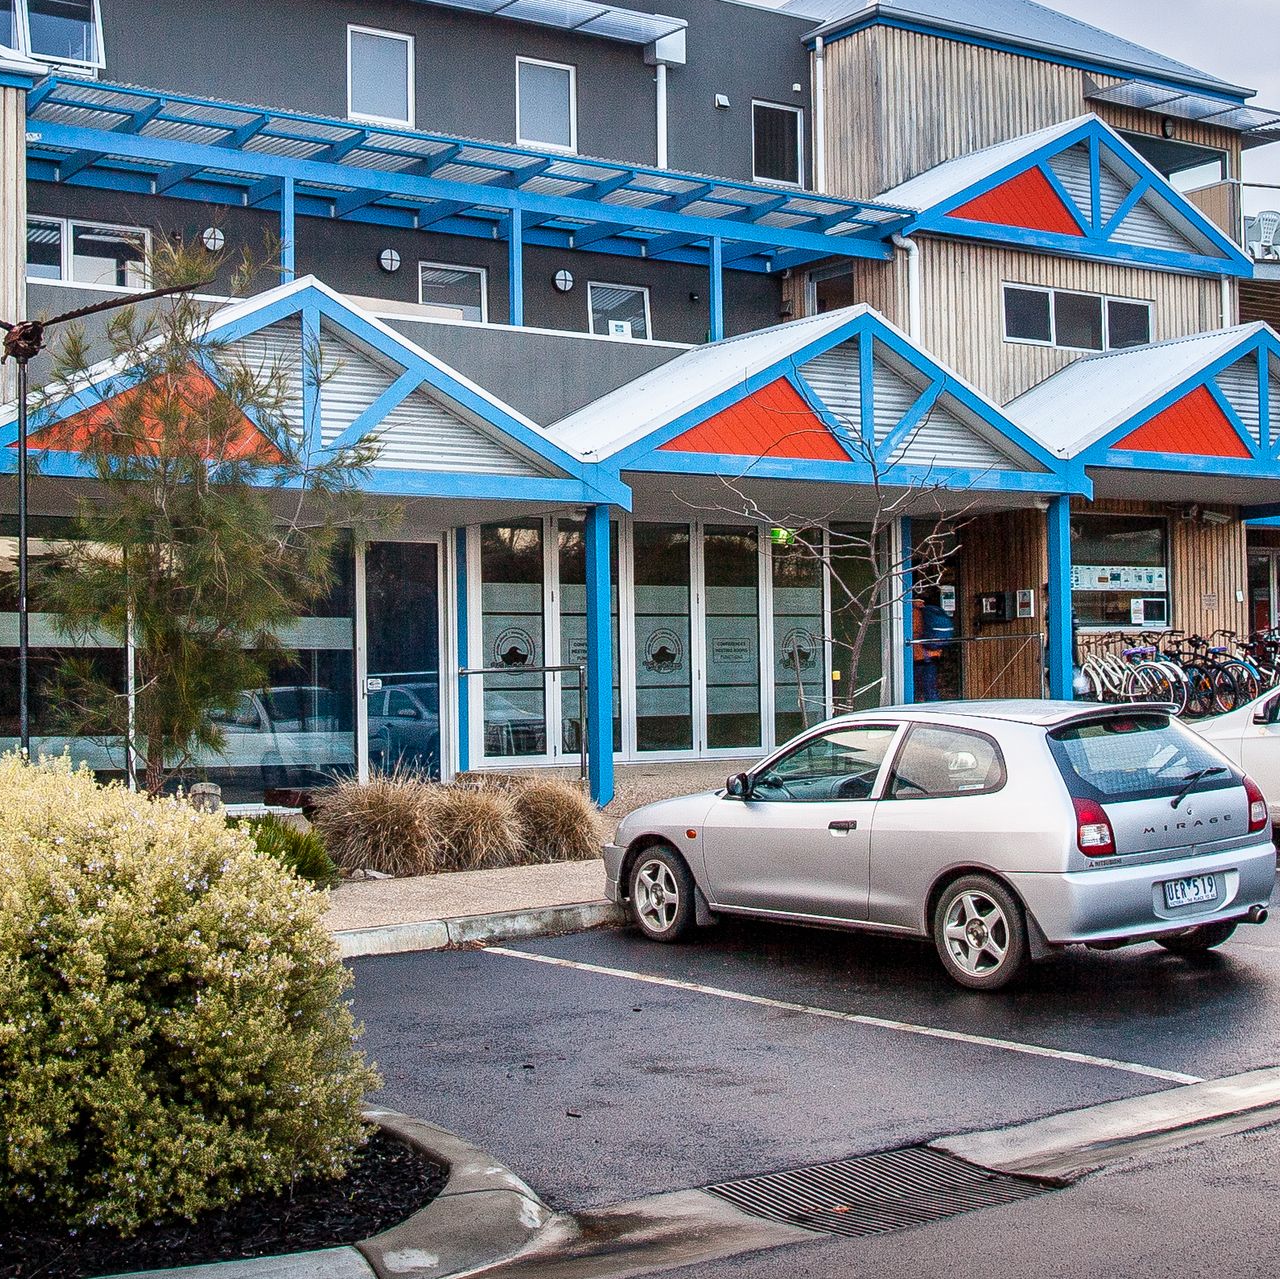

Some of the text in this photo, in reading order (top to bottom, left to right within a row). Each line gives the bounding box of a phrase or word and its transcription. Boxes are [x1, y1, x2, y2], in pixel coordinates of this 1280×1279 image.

[1143, 814, 1232, 834] MIRAGE
[1167, 876, 1214, 901] UER 519
